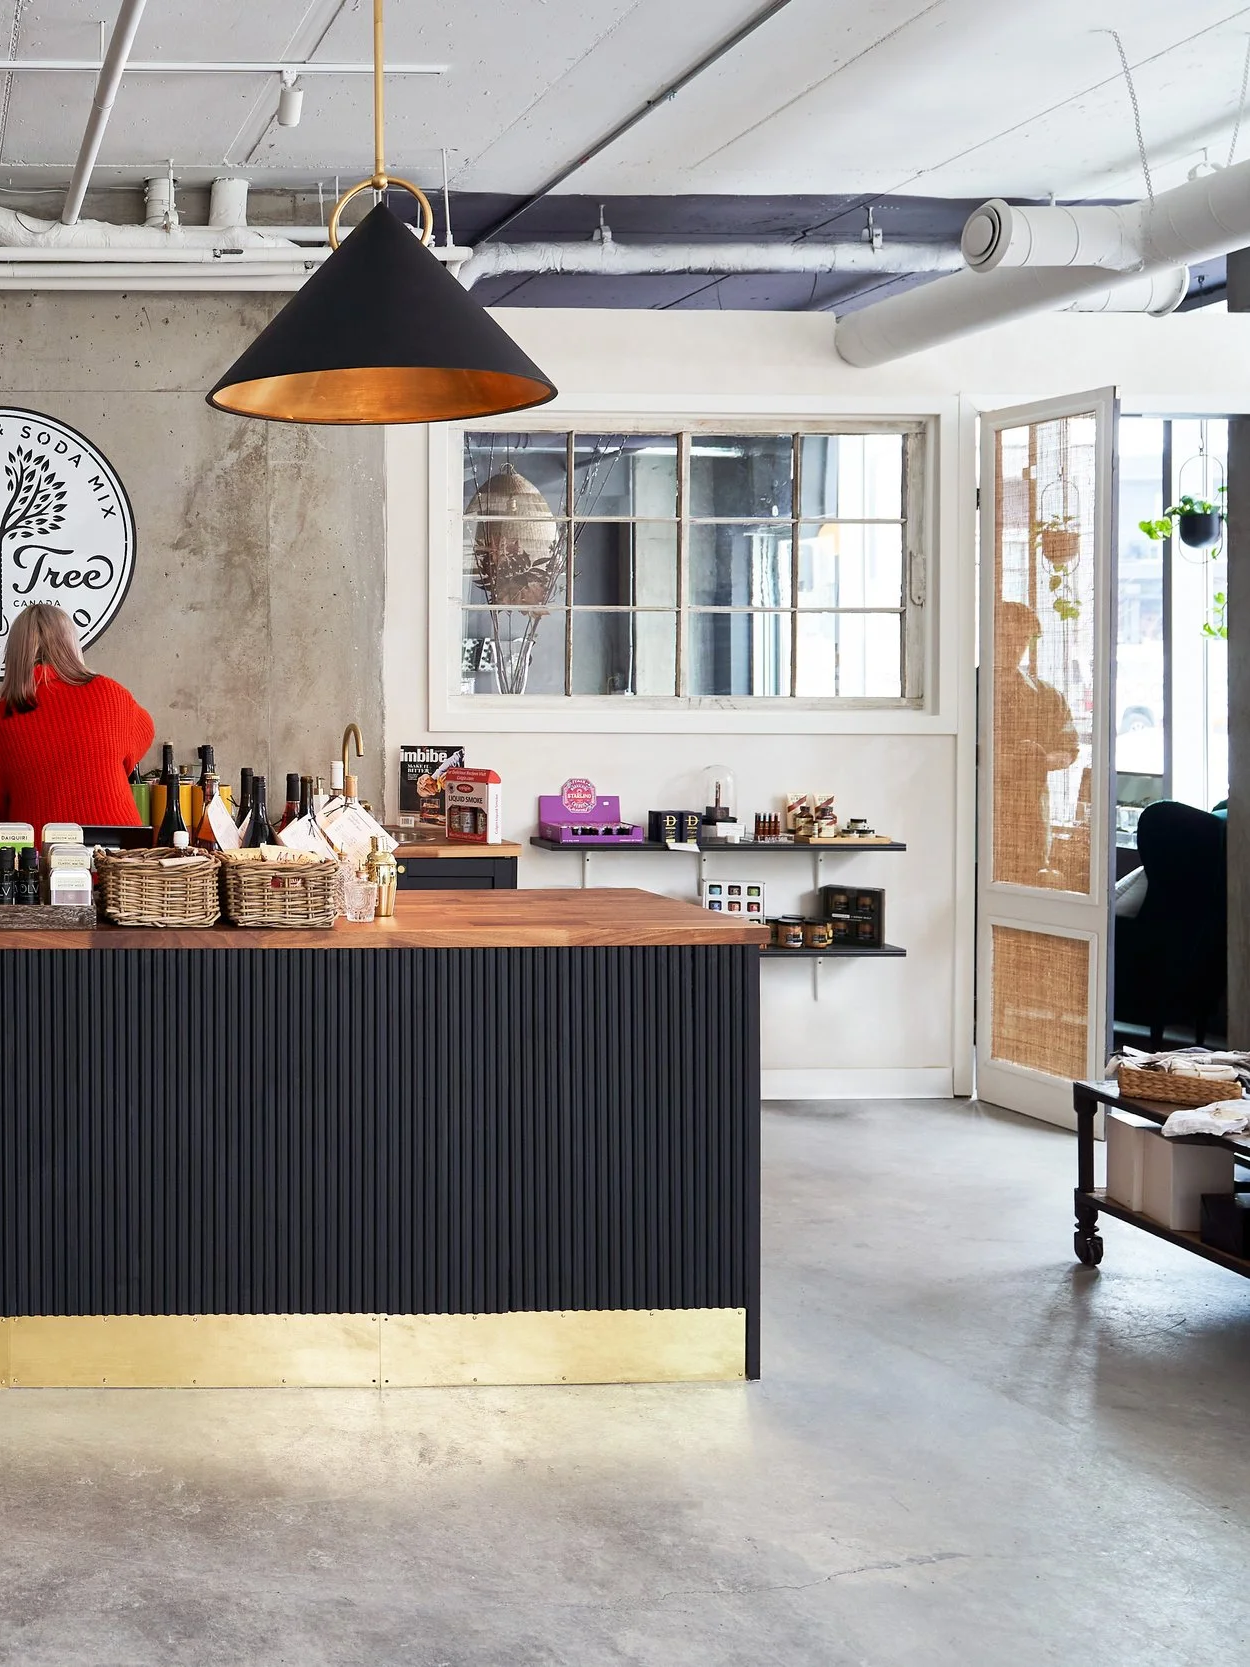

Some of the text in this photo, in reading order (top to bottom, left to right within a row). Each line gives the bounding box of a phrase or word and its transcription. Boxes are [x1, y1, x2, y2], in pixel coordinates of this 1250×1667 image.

[20, 425, 83, 468] SODA
[88, 475, 116, 519] MIX
[12, 545, 114, 594] Tree
[73, 609, 91, 628] O
[400, 748, 448, 763] imbibe
[465, 796, 483, 804] SMOKE
